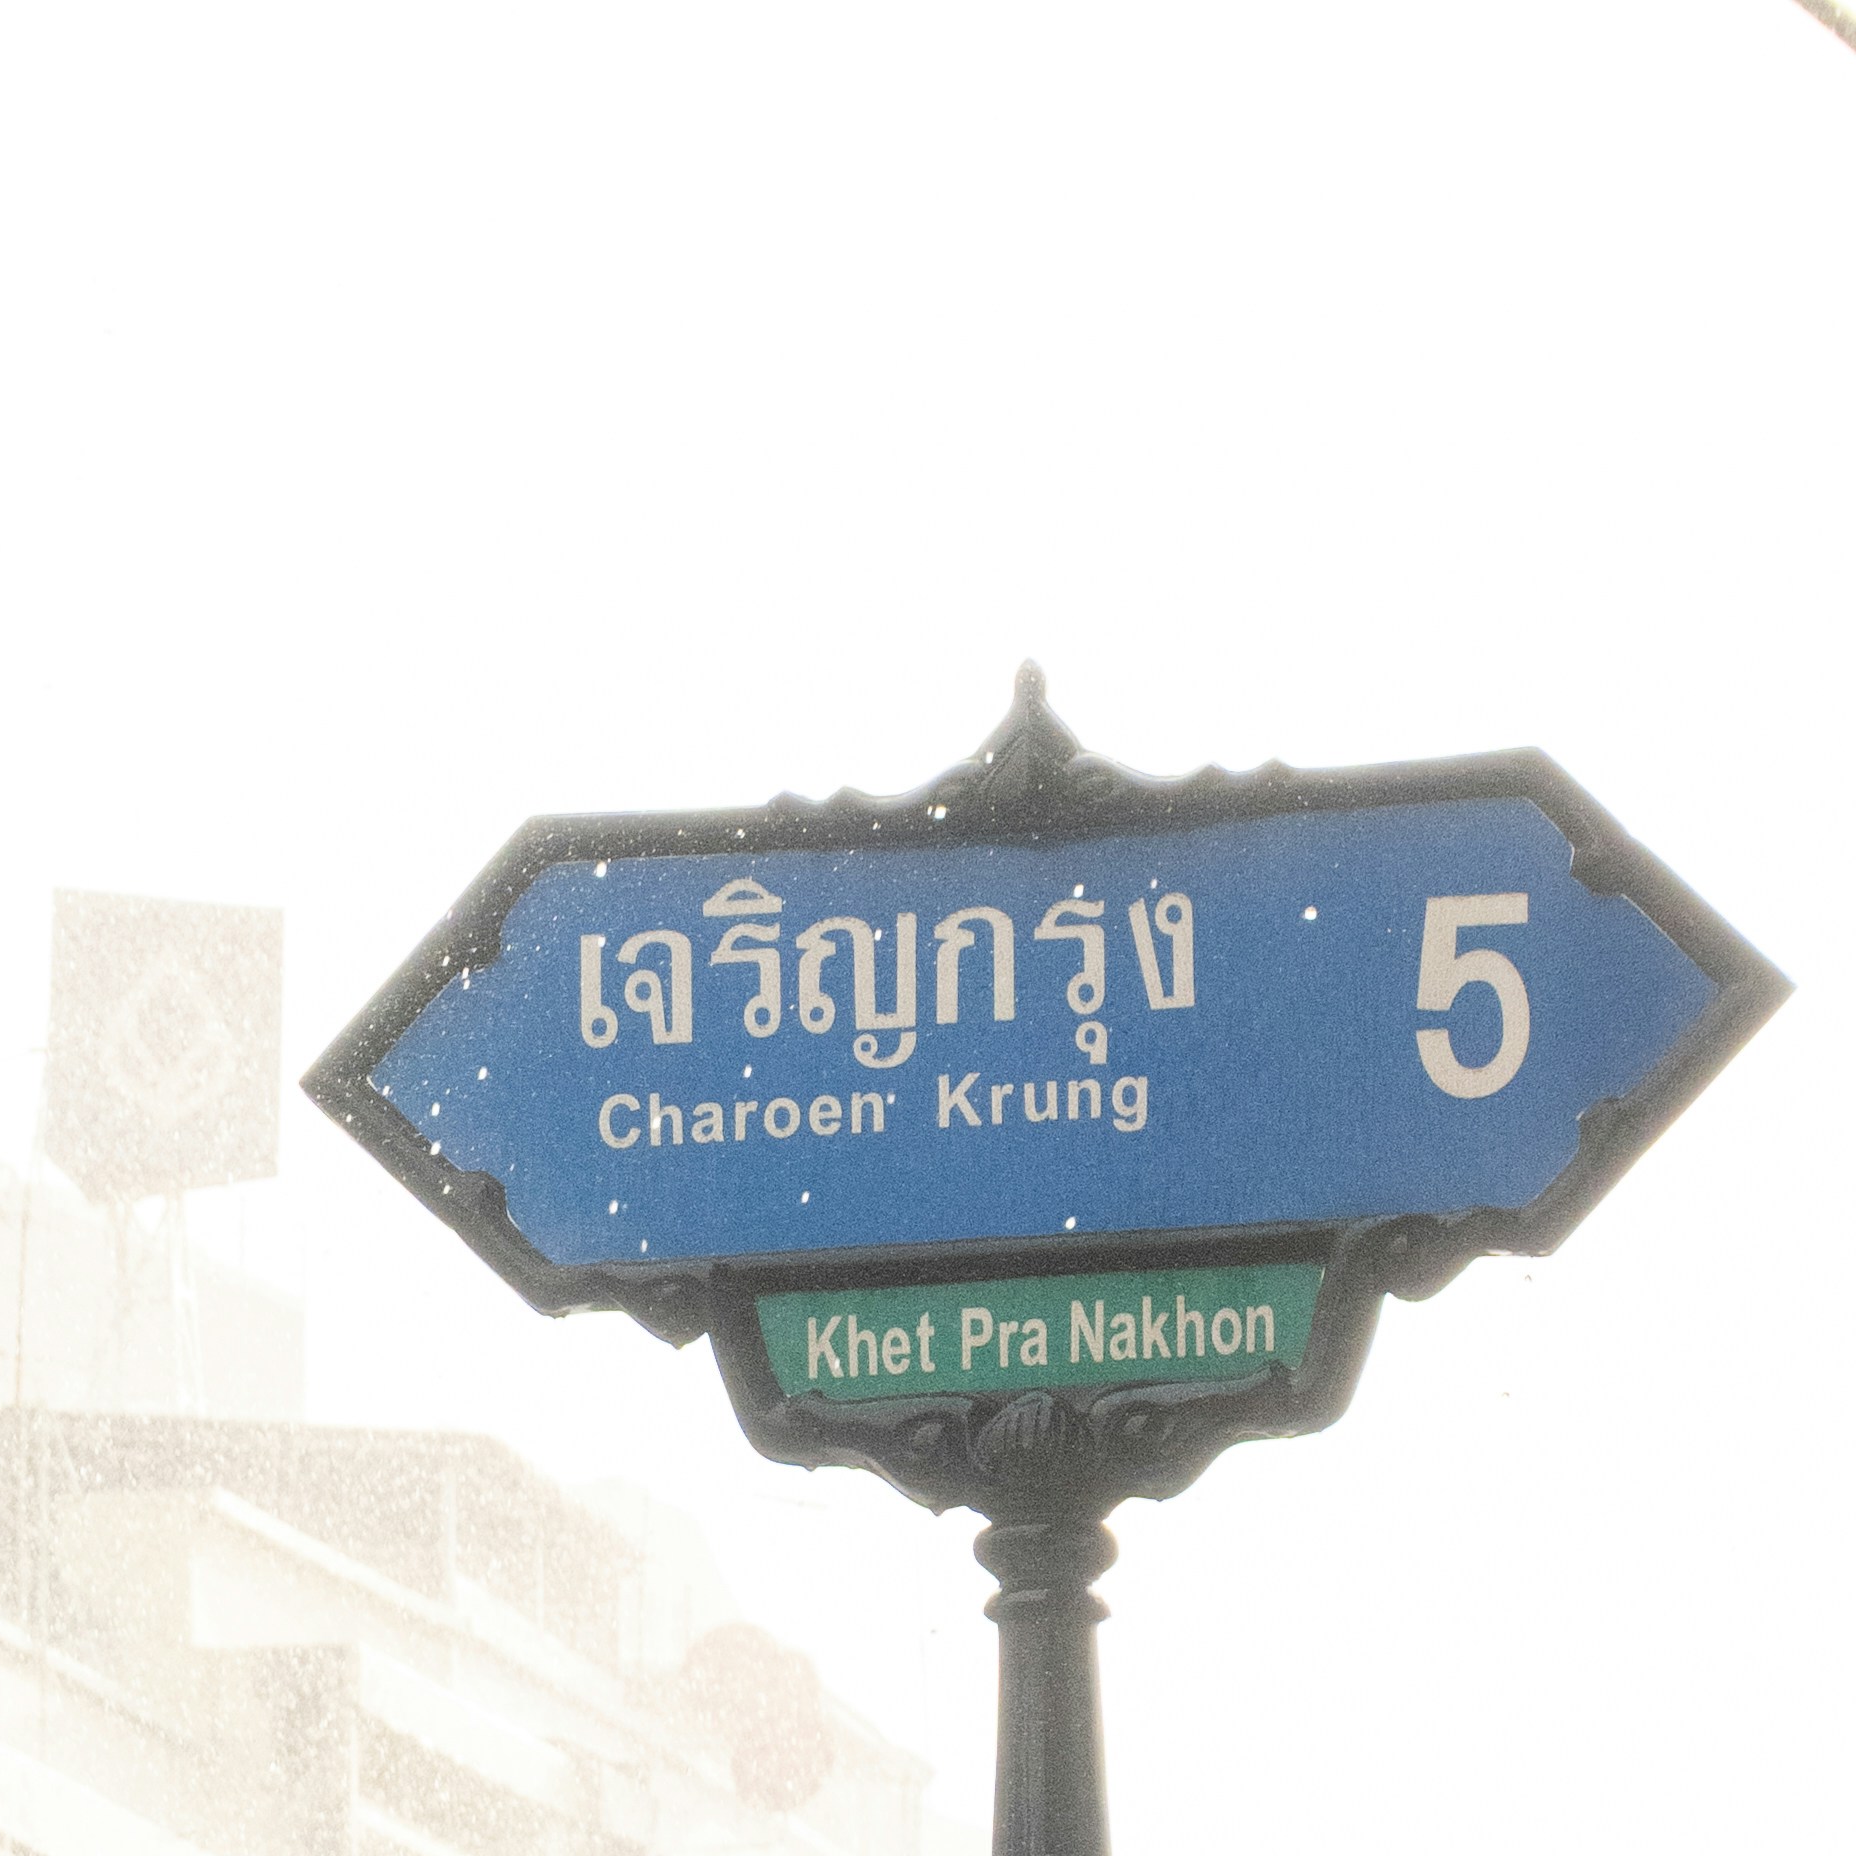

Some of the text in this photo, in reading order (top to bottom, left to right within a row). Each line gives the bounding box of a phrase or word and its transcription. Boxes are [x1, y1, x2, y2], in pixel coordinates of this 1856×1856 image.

[580, 878, 1195, 1068] เจริญกรุง
[1413, 892, 1531, 1100] 5
[598, 1071, 1148, 1149] Charoen Krung
[807, 1295, 1275, 1379] Khet Pra Nakhon
